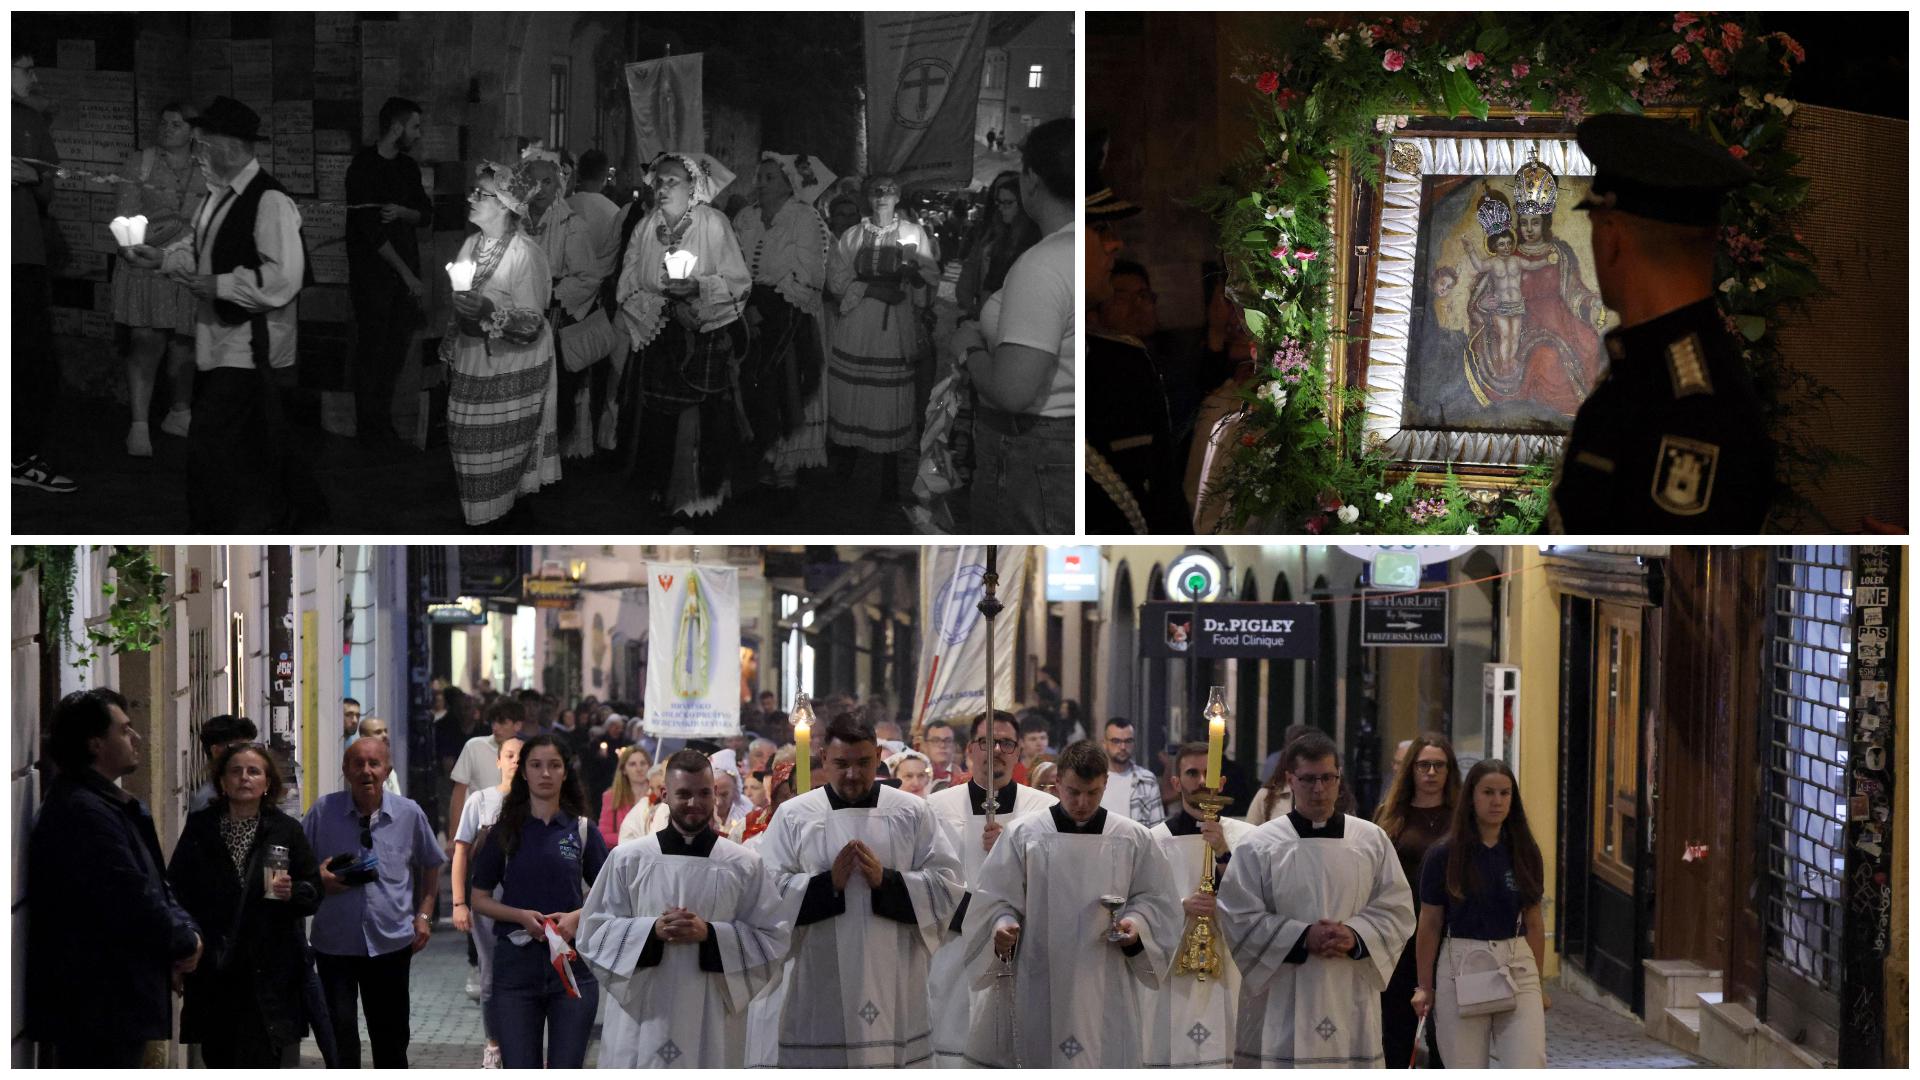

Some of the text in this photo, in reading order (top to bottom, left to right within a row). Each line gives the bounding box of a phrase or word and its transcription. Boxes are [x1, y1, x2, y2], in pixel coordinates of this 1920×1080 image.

[1203, 618, 1295, 632] Dr.PIGLEY
[1212, 634, 1285, 648] Food Clinique
[1414, 632, 1443, 641] SALON
